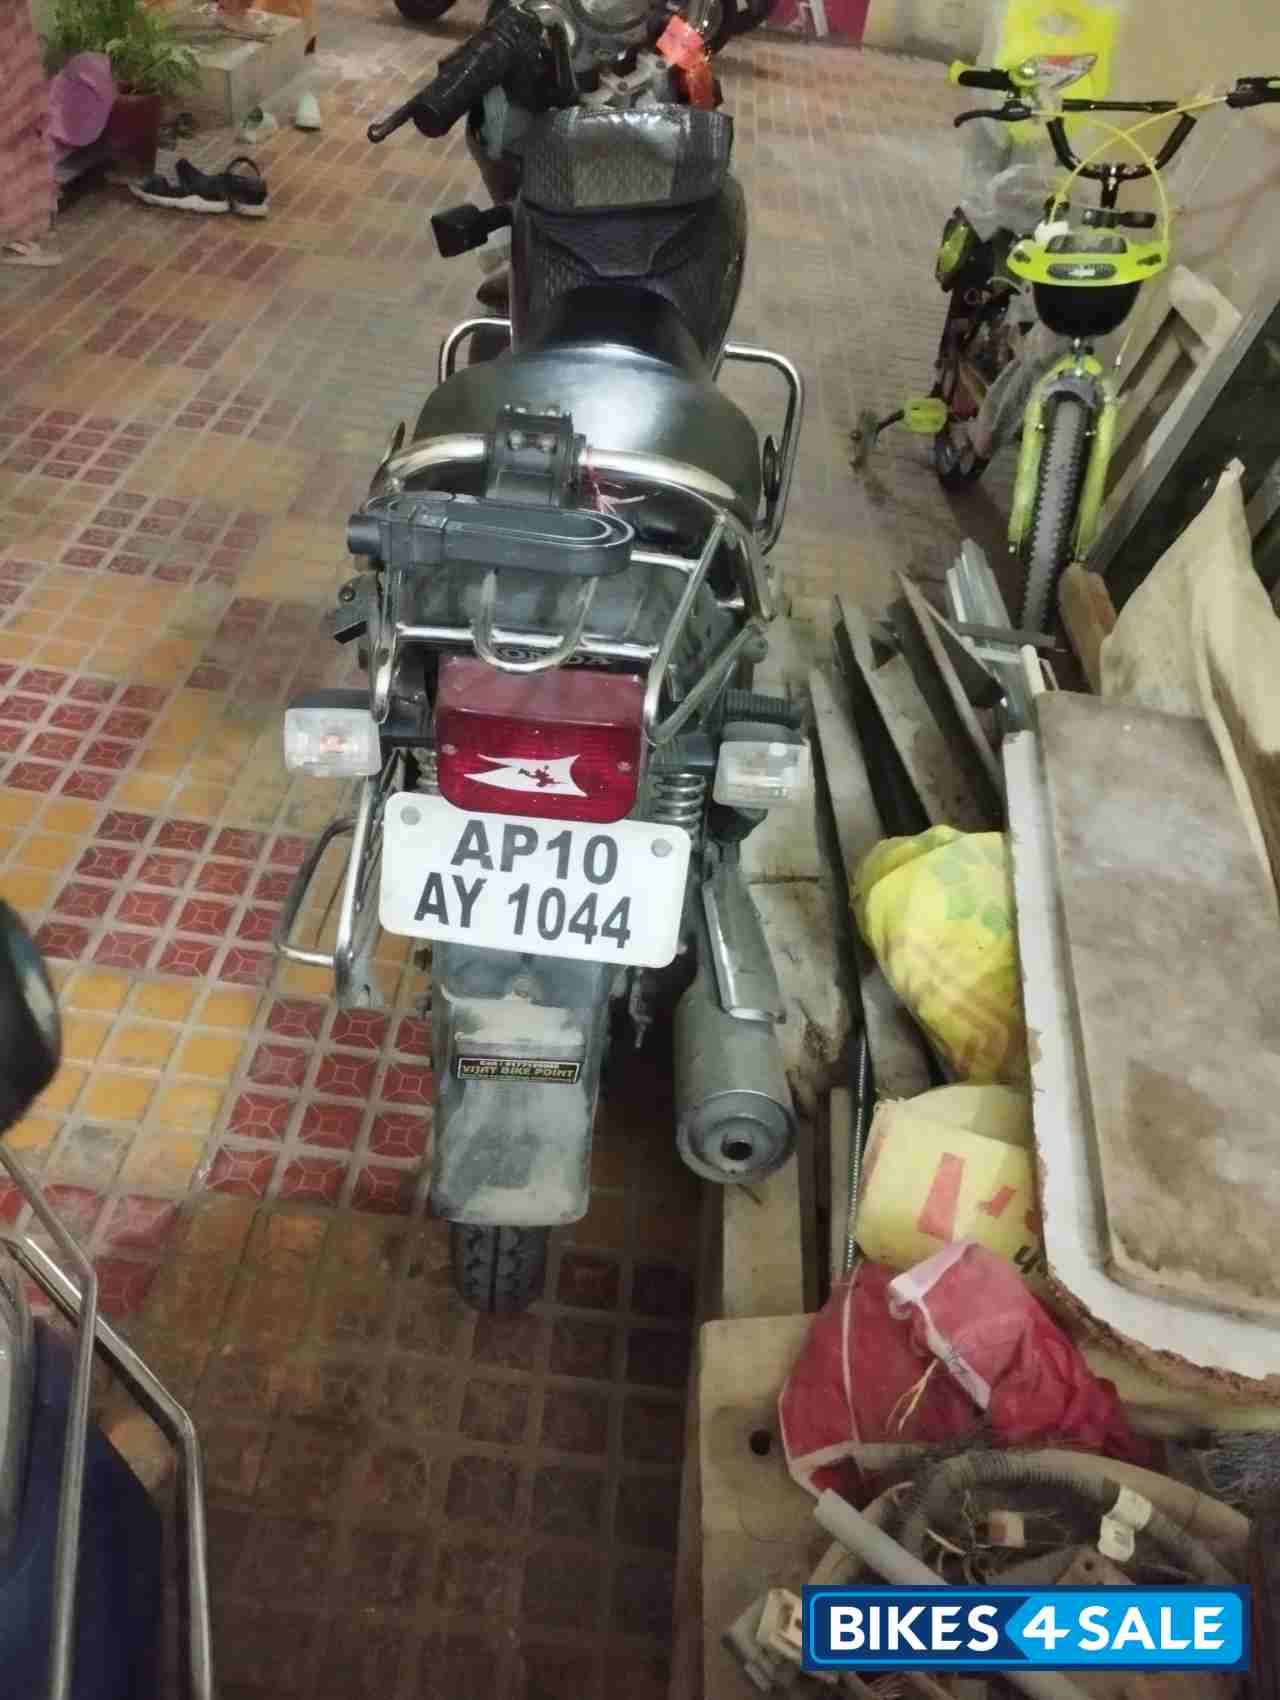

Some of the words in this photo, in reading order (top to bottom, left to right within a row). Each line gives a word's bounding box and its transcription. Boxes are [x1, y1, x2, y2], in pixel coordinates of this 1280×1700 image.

[450, 818, 619, 886] AP10
[413, 871, 488, 929] AY
[506, 882, 632, 949] 1044
